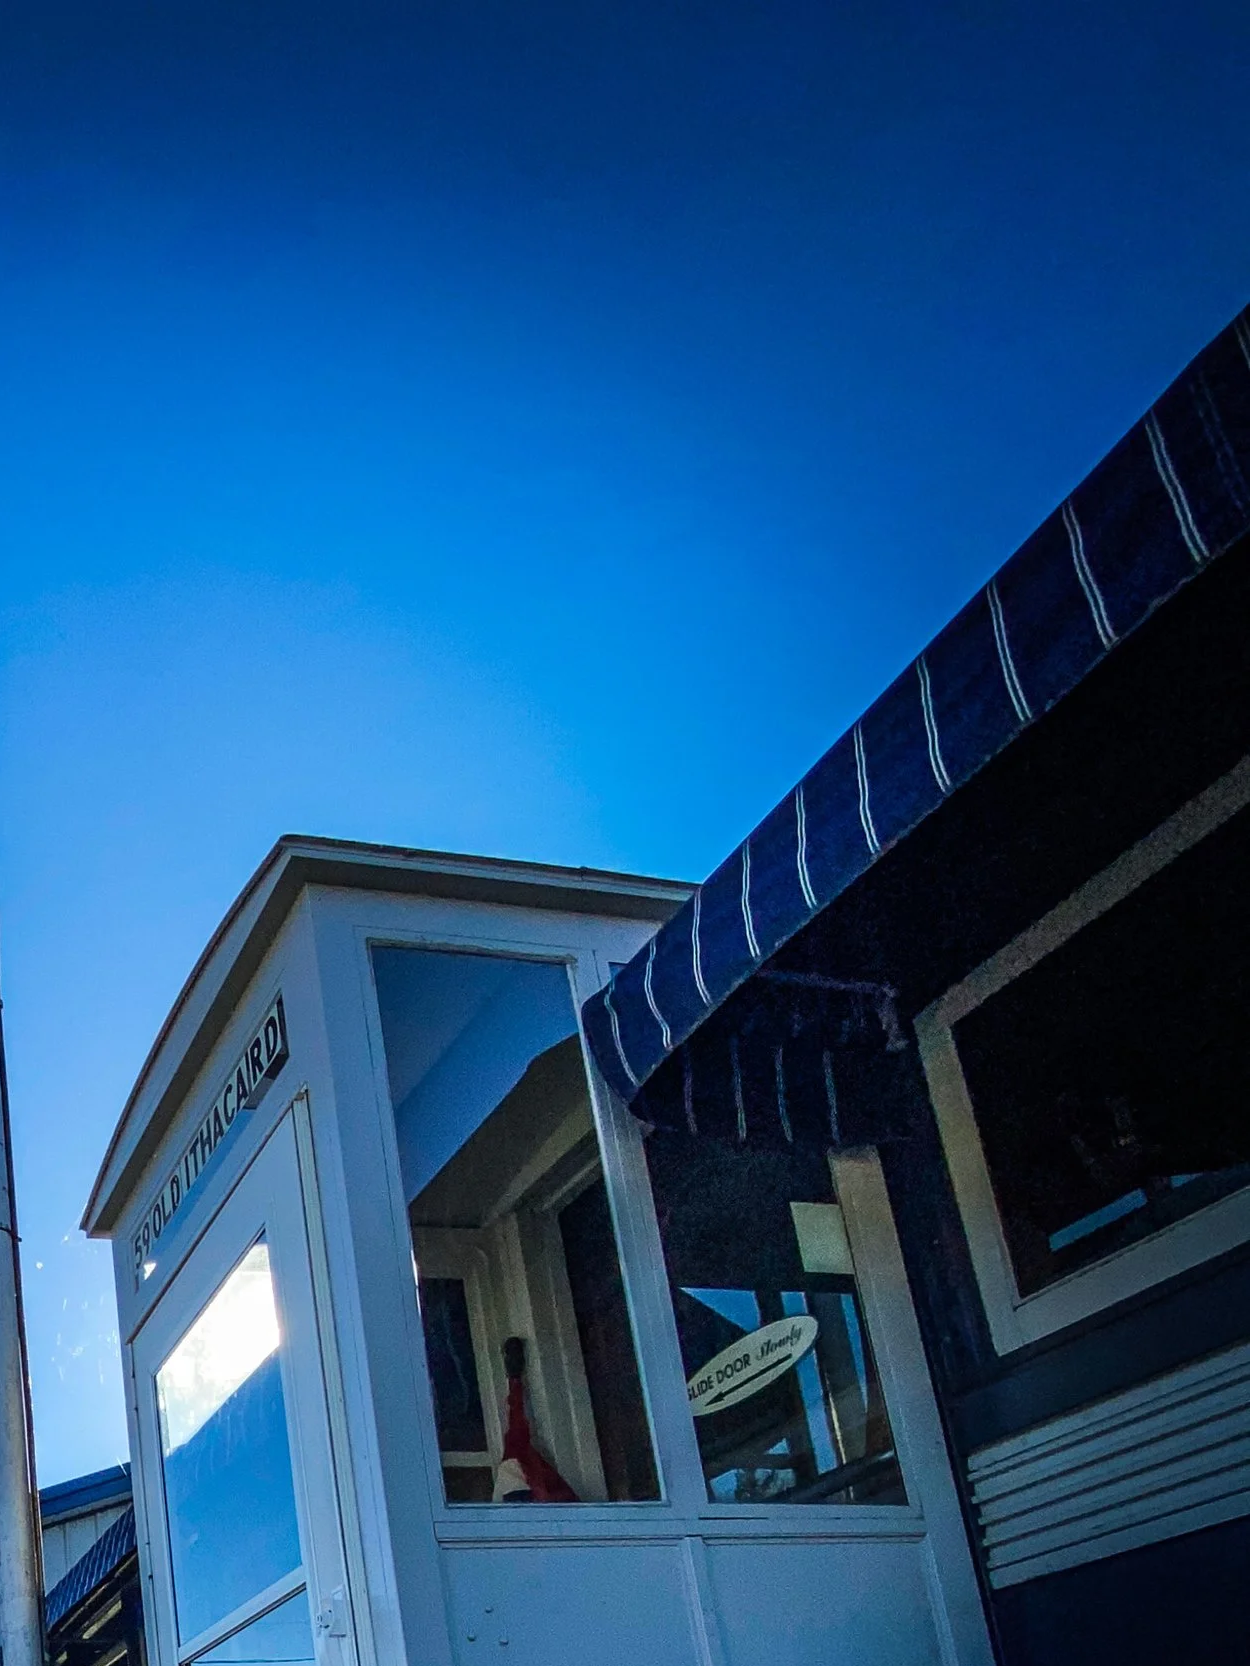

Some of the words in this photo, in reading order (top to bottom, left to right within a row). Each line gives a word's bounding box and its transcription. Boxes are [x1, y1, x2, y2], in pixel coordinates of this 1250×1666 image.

[134, 1221, 150, 1270] 59
[152, 1174, 181, 1239] OLD
[183, 1064, 249, 1192] ITHACA
[249, 1015, 279, 1085] RD
[716, 1353, 751, 1384] DOOR
[756, 1324, 802, 1361] Slowly
